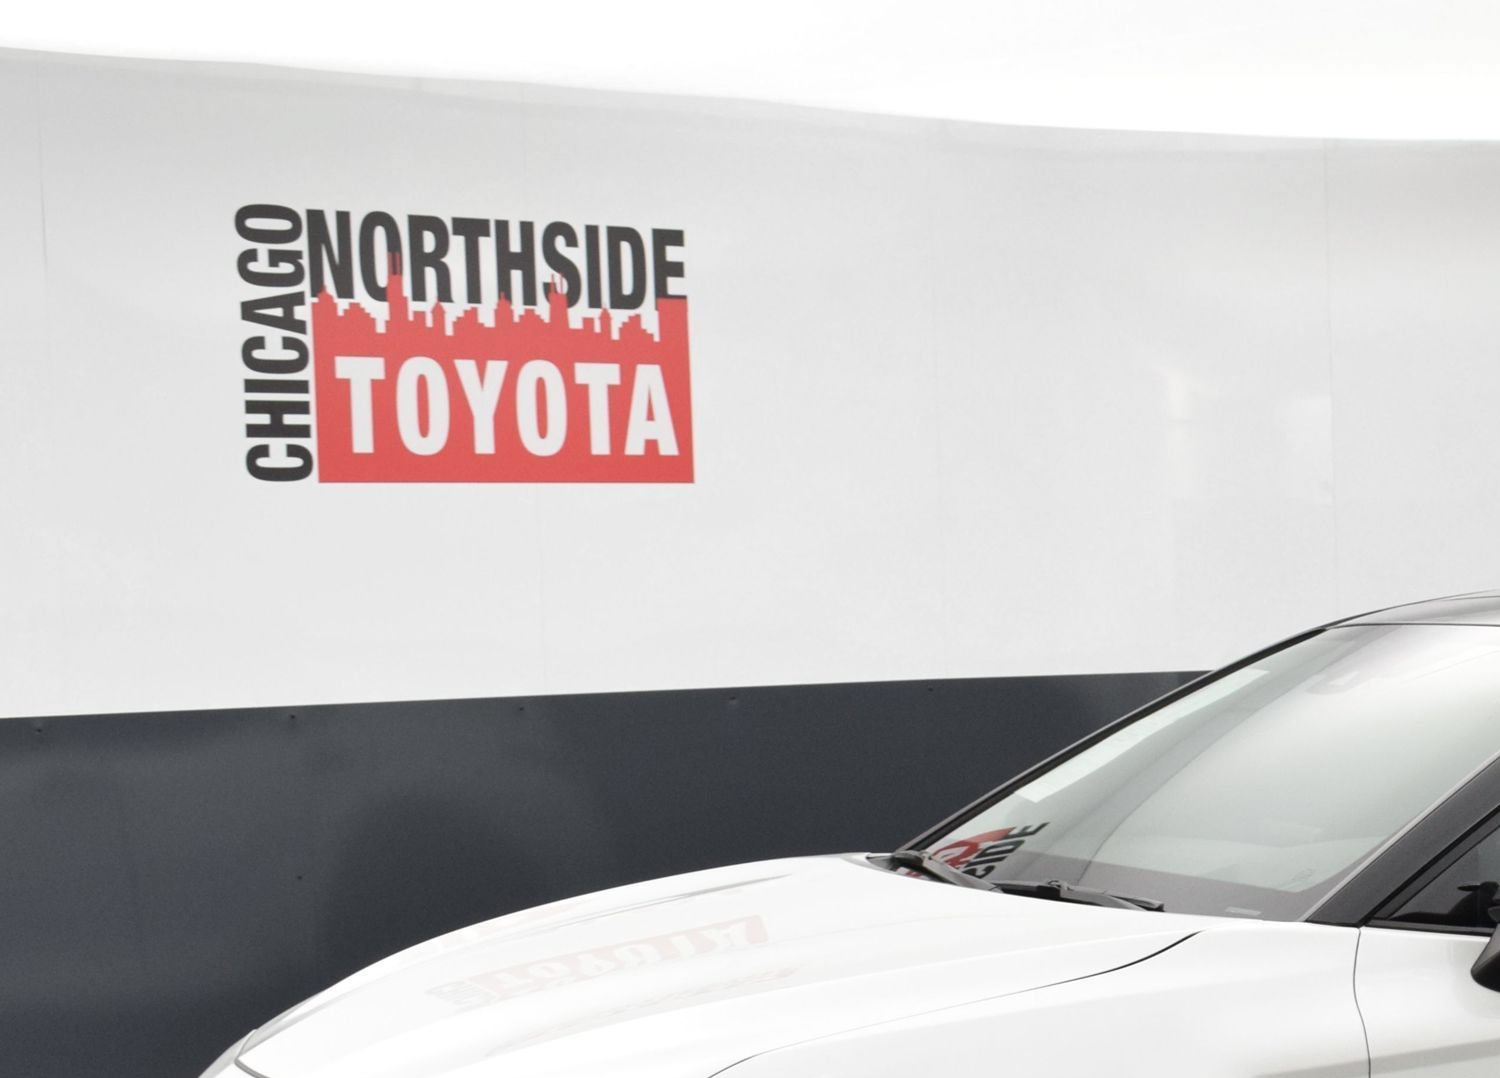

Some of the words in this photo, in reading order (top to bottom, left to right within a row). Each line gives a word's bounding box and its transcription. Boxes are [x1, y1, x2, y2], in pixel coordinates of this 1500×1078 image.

[305, 208, 688, 311] NORTHSIDE
[234, 203, 314, 483] CHICAGO
[333, 355, 681, 457] TOYOTA
